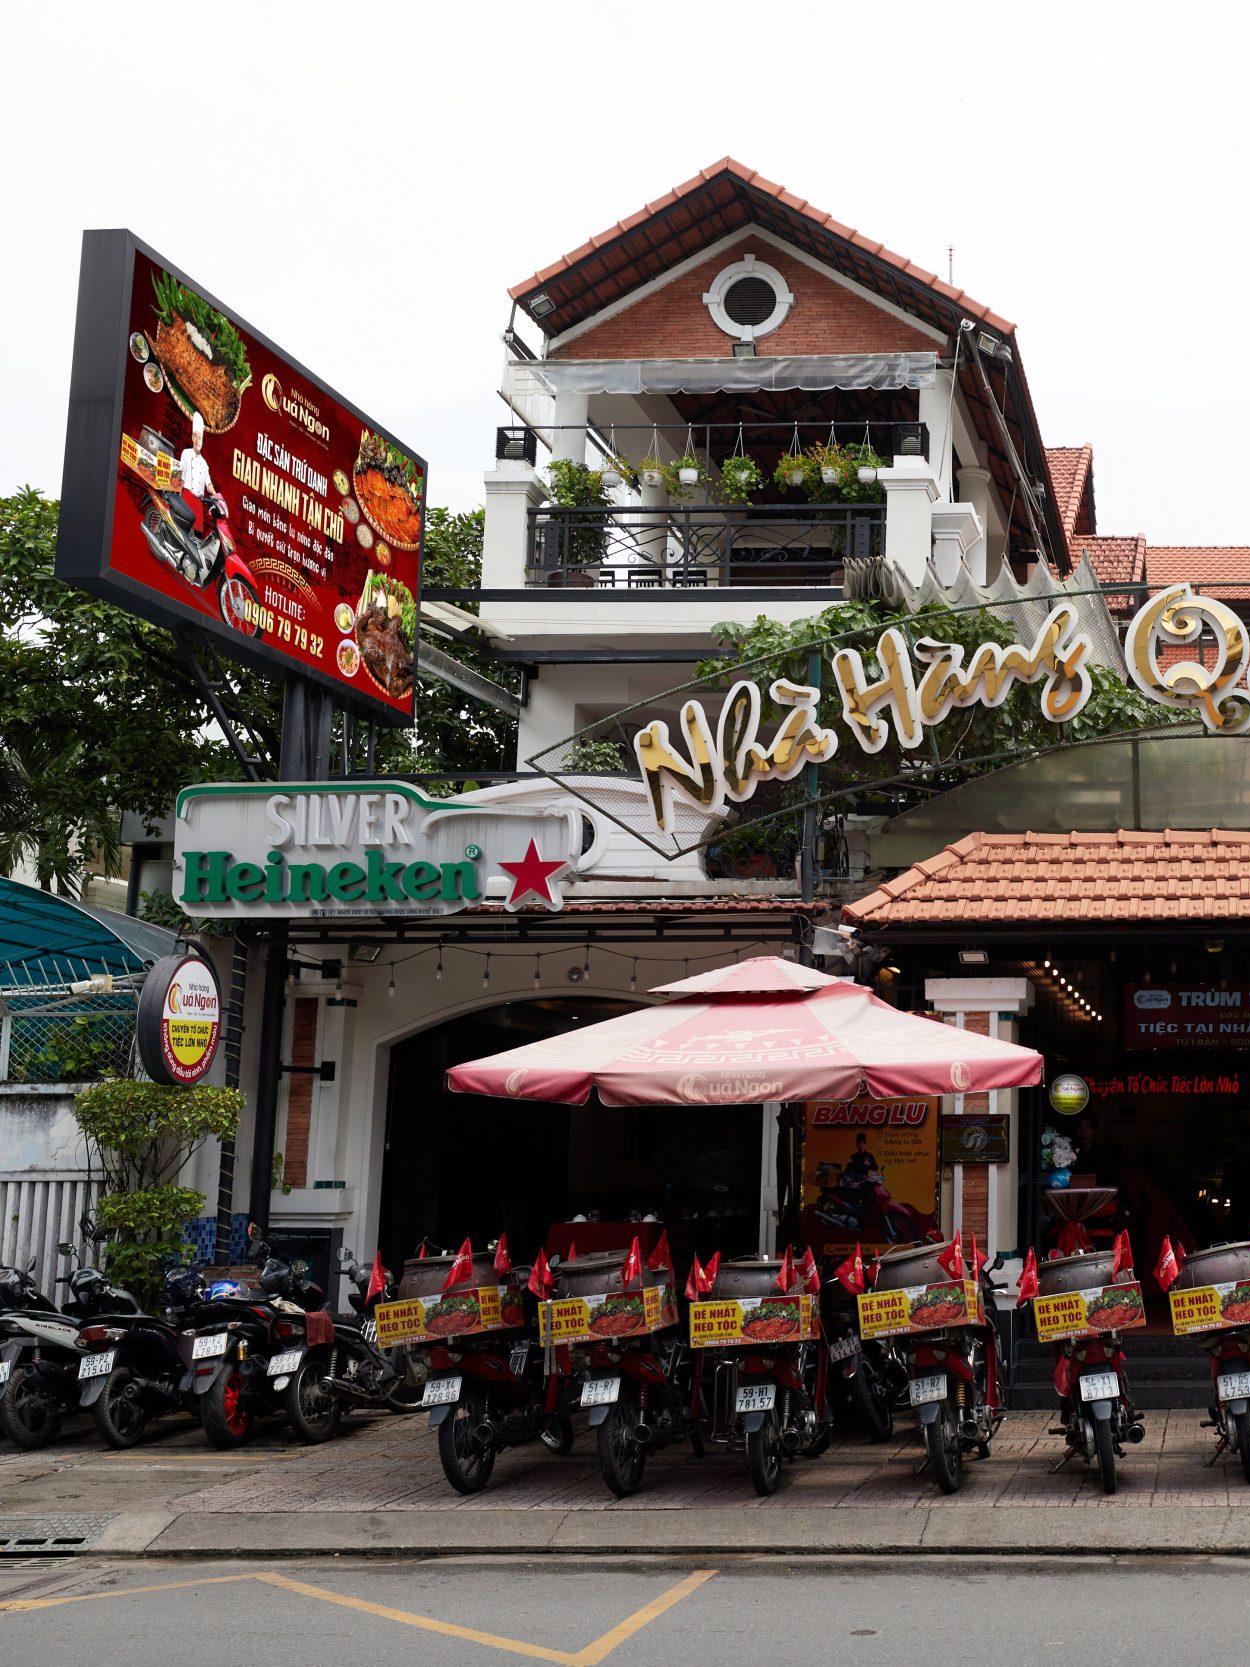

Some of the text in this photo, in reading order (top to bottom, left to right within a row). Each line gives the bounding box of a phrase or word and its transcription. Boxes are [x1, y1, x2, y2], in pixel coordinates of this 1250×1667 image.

[257, 432, 272, 461] ĐẶC
[274, 444, 290, 473] SẢN
[292, 456, 306, 483] TRỨ
[307, 468, 328, 498] DANH
[232, 448, 344, 544] GIAO NHANH TẬN CHỖ
[242, 496, 256, 514] Giao
[244, 599, 323, 658] 0906 79 79 32
[633, 679, 839, 837] Nhà
[831, 603, 1095, 754] Hàng
[266, 793, 411, 846] SILVER
[180, 849, 484, 902] Heineken
[1179, 988, 1241, 1007] TRÙM
[172, 1023, 208, 1034] CHUYÊN TỔ CHỨC
[1138, 1022, 1179, 1035] TIỆC
[1184, 1023, 1213, 1035] TẠI
[172, 1035, 207, 1048] TIỆC LỚN NHỎ
[889, 1102, 927, 1125] LU
[1173, 1292, 1214, 1309] ĐỆ NHẤT
[379, 1306, 419, 1322] ĐỆ NHẤT
[1175, 1305, 1217, 1321] HEO TỘC
[380, 1317, 421, 1333] HEO TỘC
[199, 1335, 222, 1347] 59-F2
[86, 1354, 109, 1366] 59-P2
[81, 1363, 110, 1377] 215.40
[430, 1380, 455, 1392] 59-X4
[743, 1387, 768, 1398] 59-H1
[426, 1391, 457, 1403] 128.96
[738, 1398, 772, 1409] 781.57
